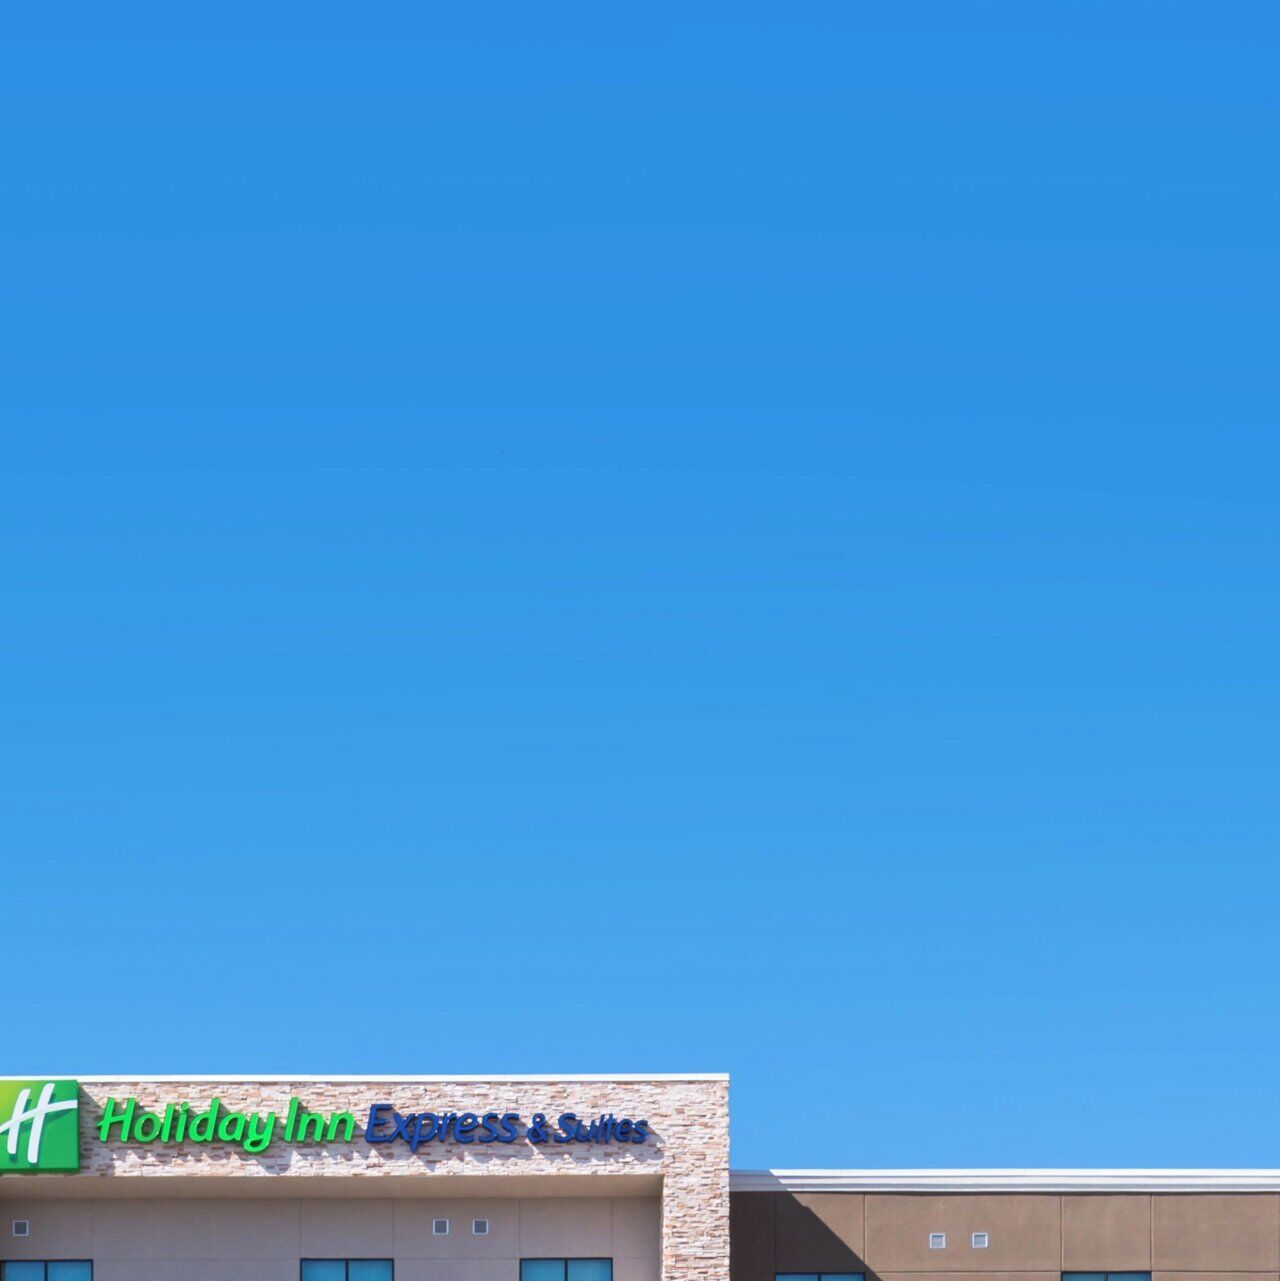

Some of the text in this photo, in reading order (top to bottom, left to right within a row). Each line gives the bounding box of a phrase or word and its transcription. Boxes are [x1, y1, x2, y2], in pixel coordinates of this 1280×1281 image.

[96, 1096, 649, 1153] Holiday Inn Express & Suites
